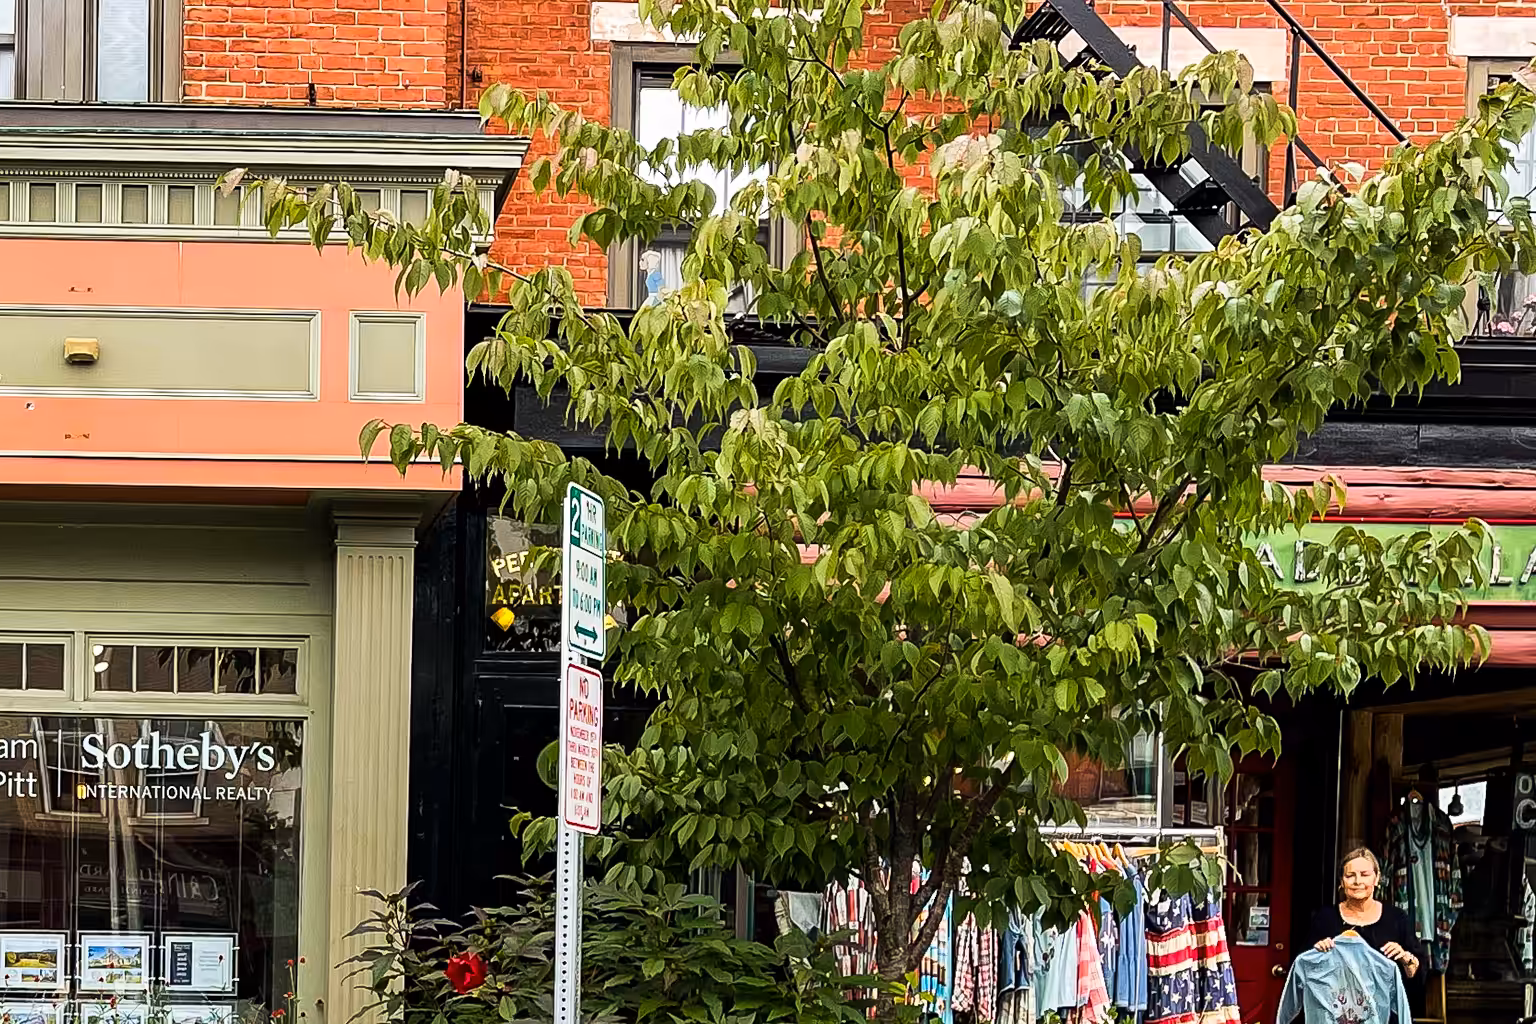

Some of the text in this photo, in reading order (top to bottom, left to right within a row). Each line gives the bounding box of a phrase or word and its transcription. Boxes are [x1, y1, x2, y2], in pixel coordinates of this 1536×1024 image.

[570, 497, 581, 539] 2
[586, 500, 597, 525] HR
[579, 676, 590, 699] NO
[569, 698, 599, 727] PARKING
[80, 731, 276, 781] Sotheby's
[81, 783, 212, 800] INTERNATIONAL
[215, 787, 274, 801] REALTY
